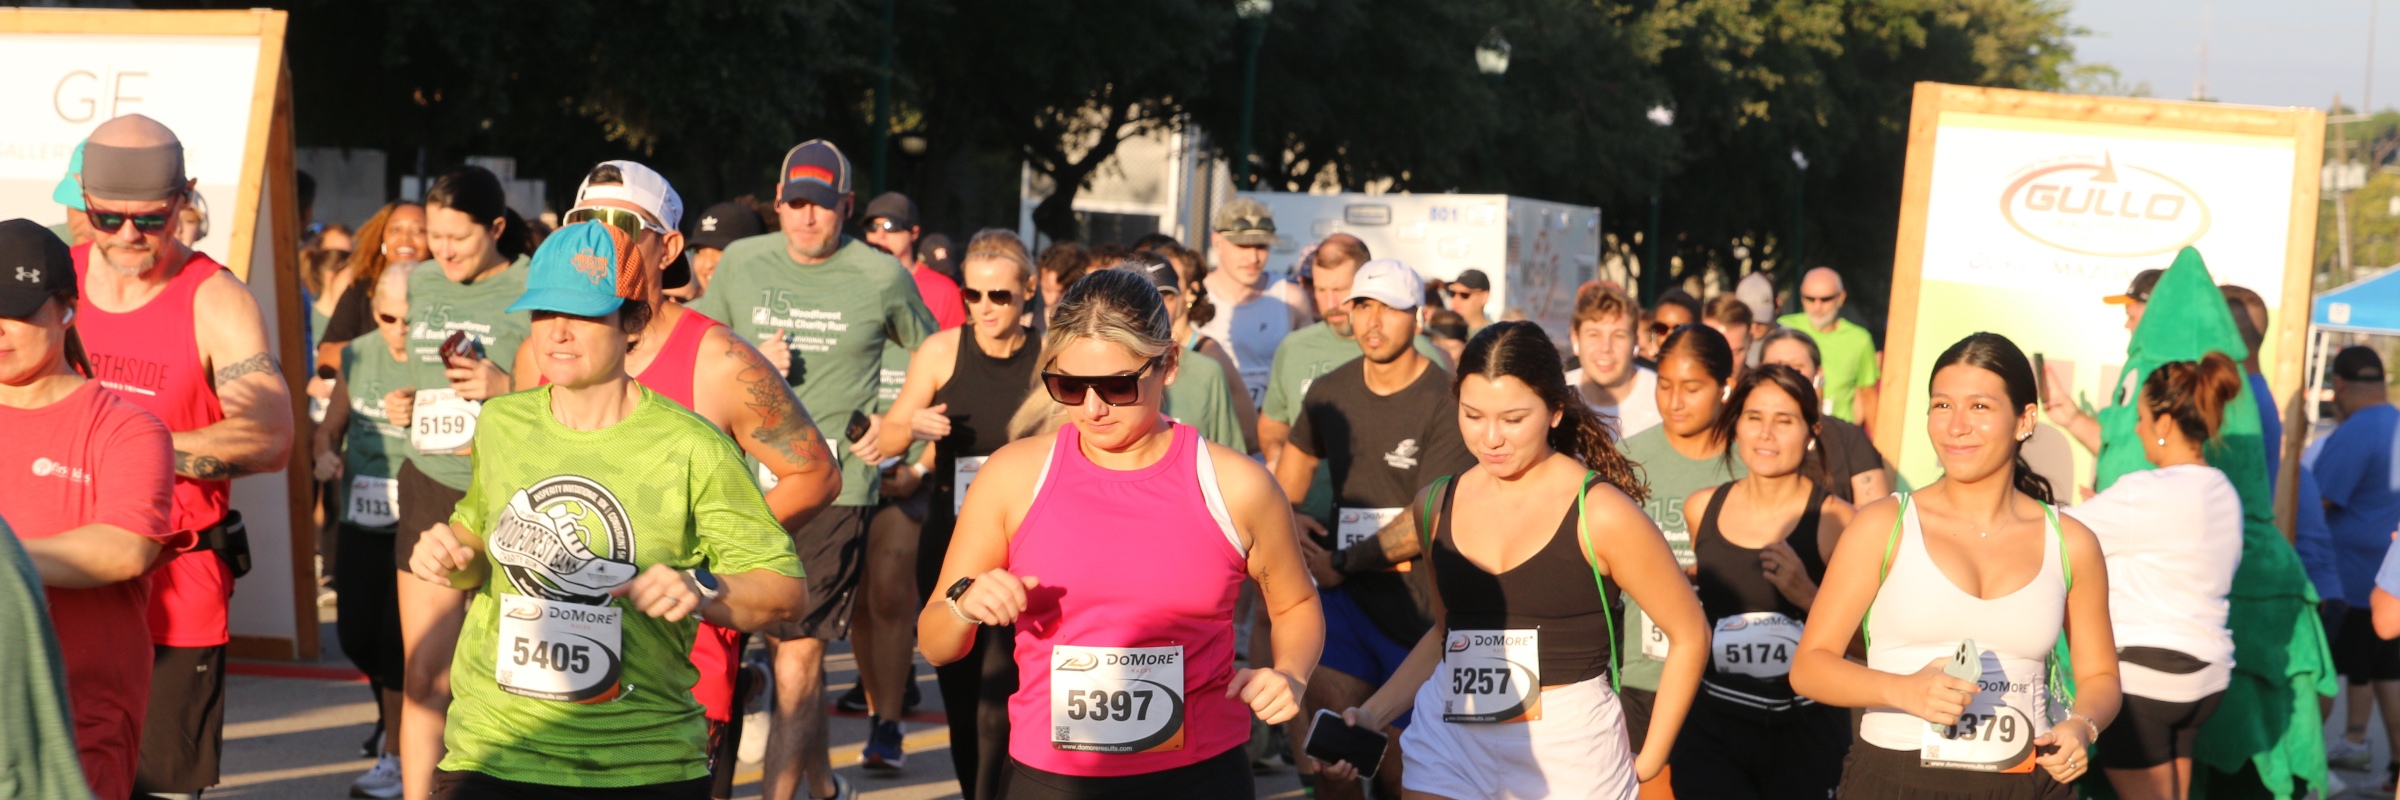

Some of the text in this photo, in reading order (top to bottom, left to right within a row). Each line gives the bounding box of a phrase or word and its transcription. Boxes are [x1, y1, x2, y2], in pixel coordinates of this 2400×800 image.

[2024, 183, 2187, 222] GULLO
[90, 353, 170, 391] RTHSIDE
[420, 416, 465, 435] 5159
[356, 497, 390, 517] 5133
[1650, 499, 1684, 527] 15
[513, 636, 590, 674] 5405
[1725, 643, 1788, 663] 5174
[1453, 667, 1511, 695] 5257
[1067, 690, 1153, 721] 5397
[1061, 744, 1133, 752] www.domoreresults.com
